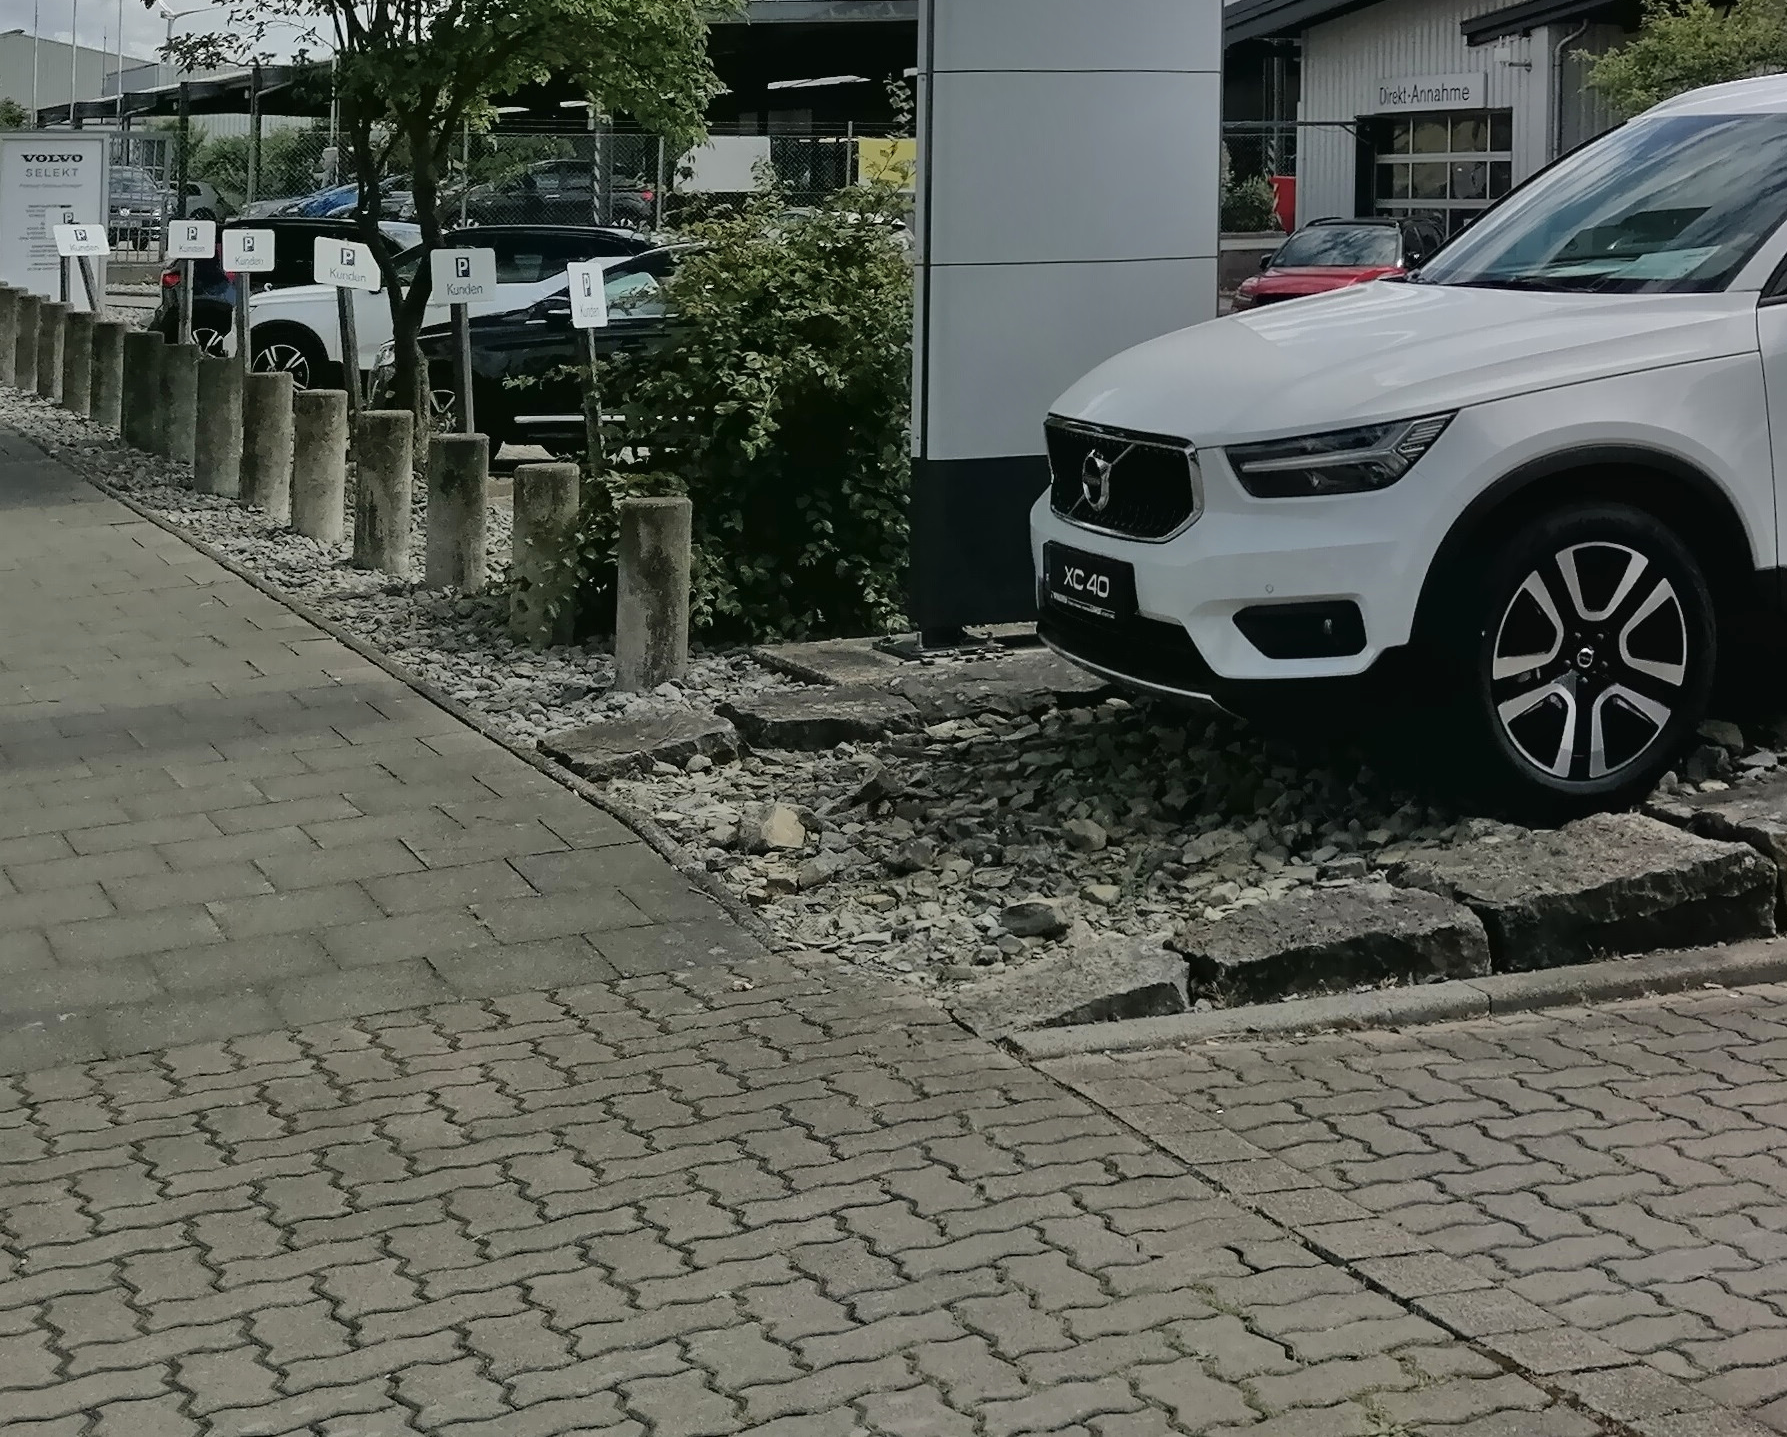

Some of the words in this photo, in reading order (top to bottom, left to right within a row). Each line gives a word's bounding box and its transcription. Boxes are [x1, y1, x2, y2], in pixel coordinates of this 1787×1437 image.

[20, 154, 83, 163] VOLVO
[25, 168, 79, 178] SELEKT
[74, 229, 87, 241] P
[187, 227, 198, 241] P
[243, 236, 255, 252] P
[235, 257, 264, 266] Kunden
[341, 248, 355, 266] P
[455, 257, 470, 277] P
[329, 267, 367, 282] Kunden
[446, 283, 484, 296] Kunden
[582, 273, 592, 297] P
[1063, 565, 1085, 591] XC
[1086, 573, 1110, 599] 40
